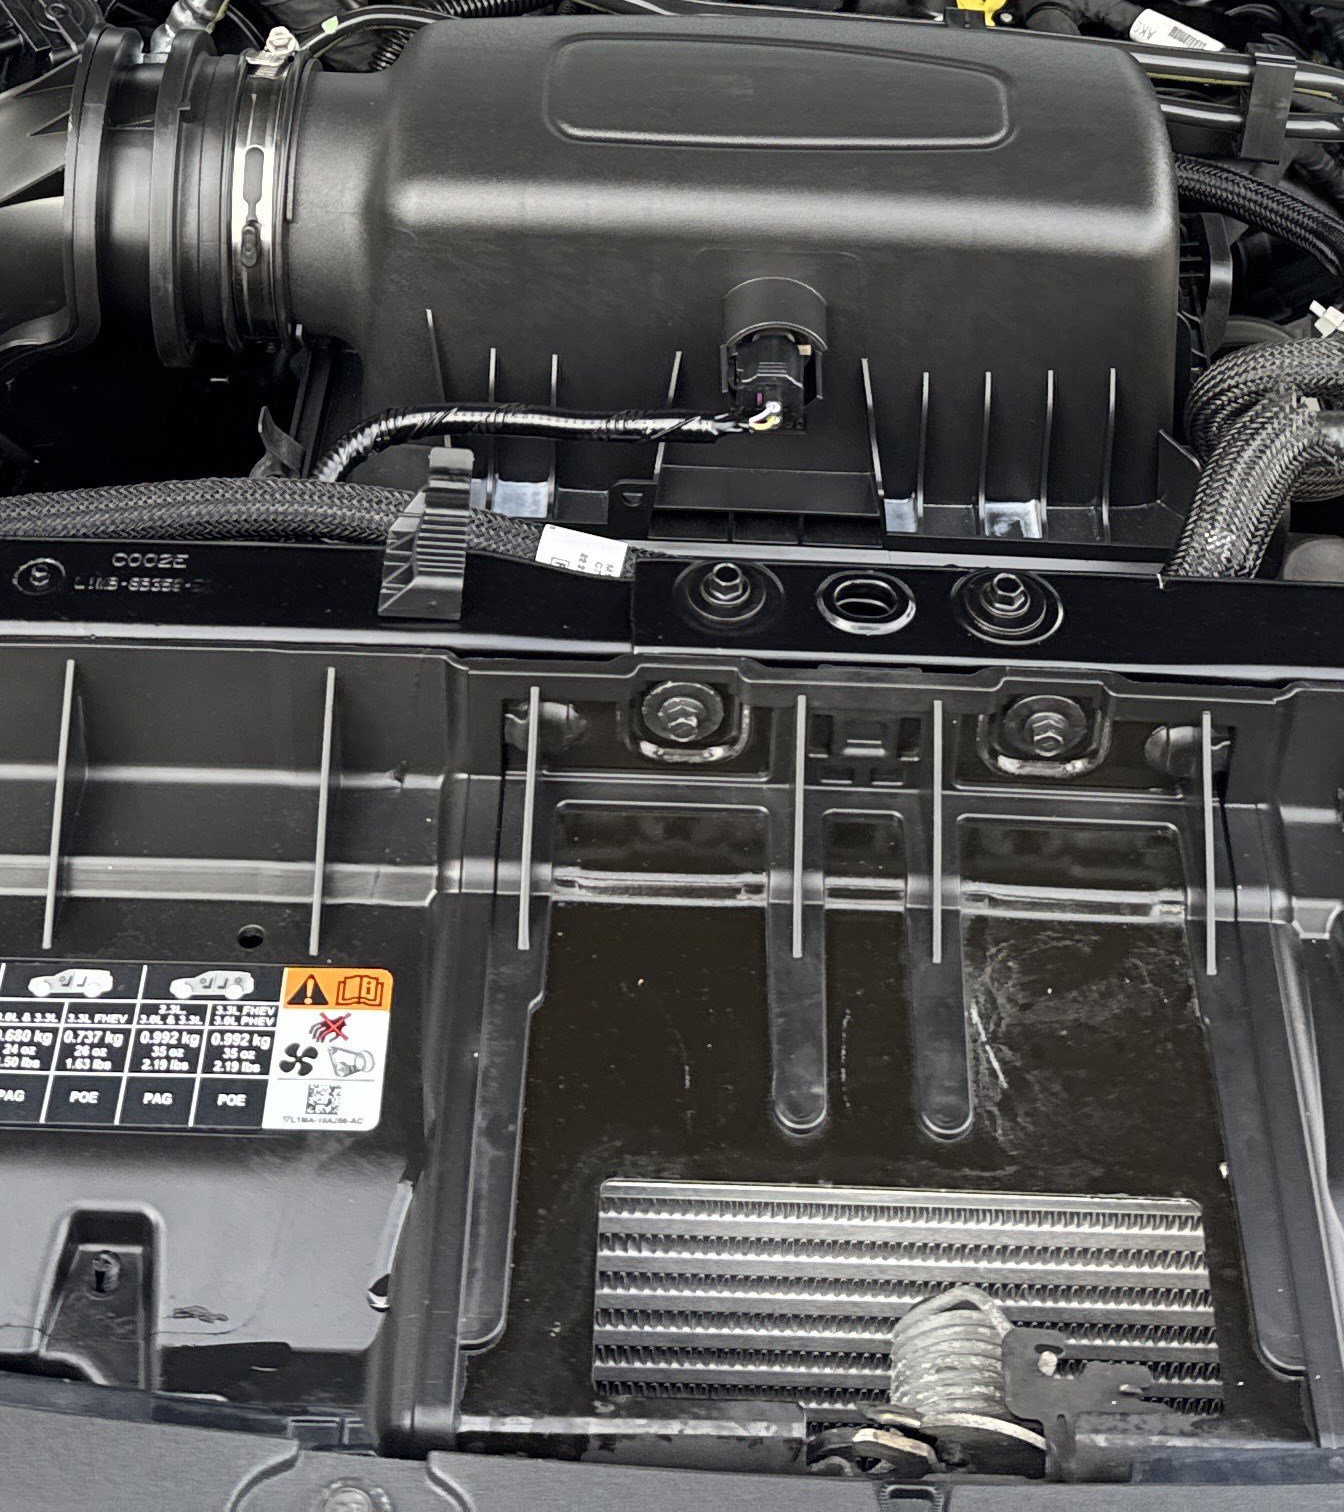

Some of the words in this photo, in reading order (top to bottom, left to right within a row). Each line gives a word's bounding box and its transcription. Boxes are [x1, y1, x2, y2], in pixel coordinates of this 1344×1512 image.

[21, 1012, 31, 1022] &
[215, 1005, 241, 1016] 3.3L
[241, 1006, 276, 1016] FHEV
[67, 1012, 92, 1023] 3.3L
[94, 1013, 129, 1024] FHEV
[166, 1014, 176, 1025] &
[214, 1015, 239, 1026] 3.0L
[240, 1016, 275, 1026] PHEV
[34, 1029, 53, 1046] kg
[63, 1029, 103, 1044] 0.737
[104, 1030, 124, 1048] kg
[139, 1030, 180, 1044] 0.992
[181, 1031, 201, 1048] kg
[210, 1032, 251, 1047] 0.992
[252, 1033, 271, 1050] kg
[2, 1043, 19, 1055] 24
[20, 1046, 37, 1055] oz
[74, 1045, 90, 1057] 26
[91, 1047, 108, 1057] oz
[150, 1046, 168, 1058] 35
[168, 1048, 185, 1058] oz
[222, 1047, 239, 1060] 35
[239, 1050, 256, 1060] oz
[20, 1056, 41, 1069] lbs
[65, 1058, 91, 1070] 1.63
[92, 1058, 112, 1070] lbs
[141, 1058, 168, 1071] 2.19
[169, 1059, 190, 1071] lbs
[213, 1060, 240, 1072] 2.19
[241, 1061, 261, 1073] lbs
[69, 1090, 99, 1104] POE
[143, 1092, 173, 1105] PAG
[217, 1093, 247, 1107] POE
